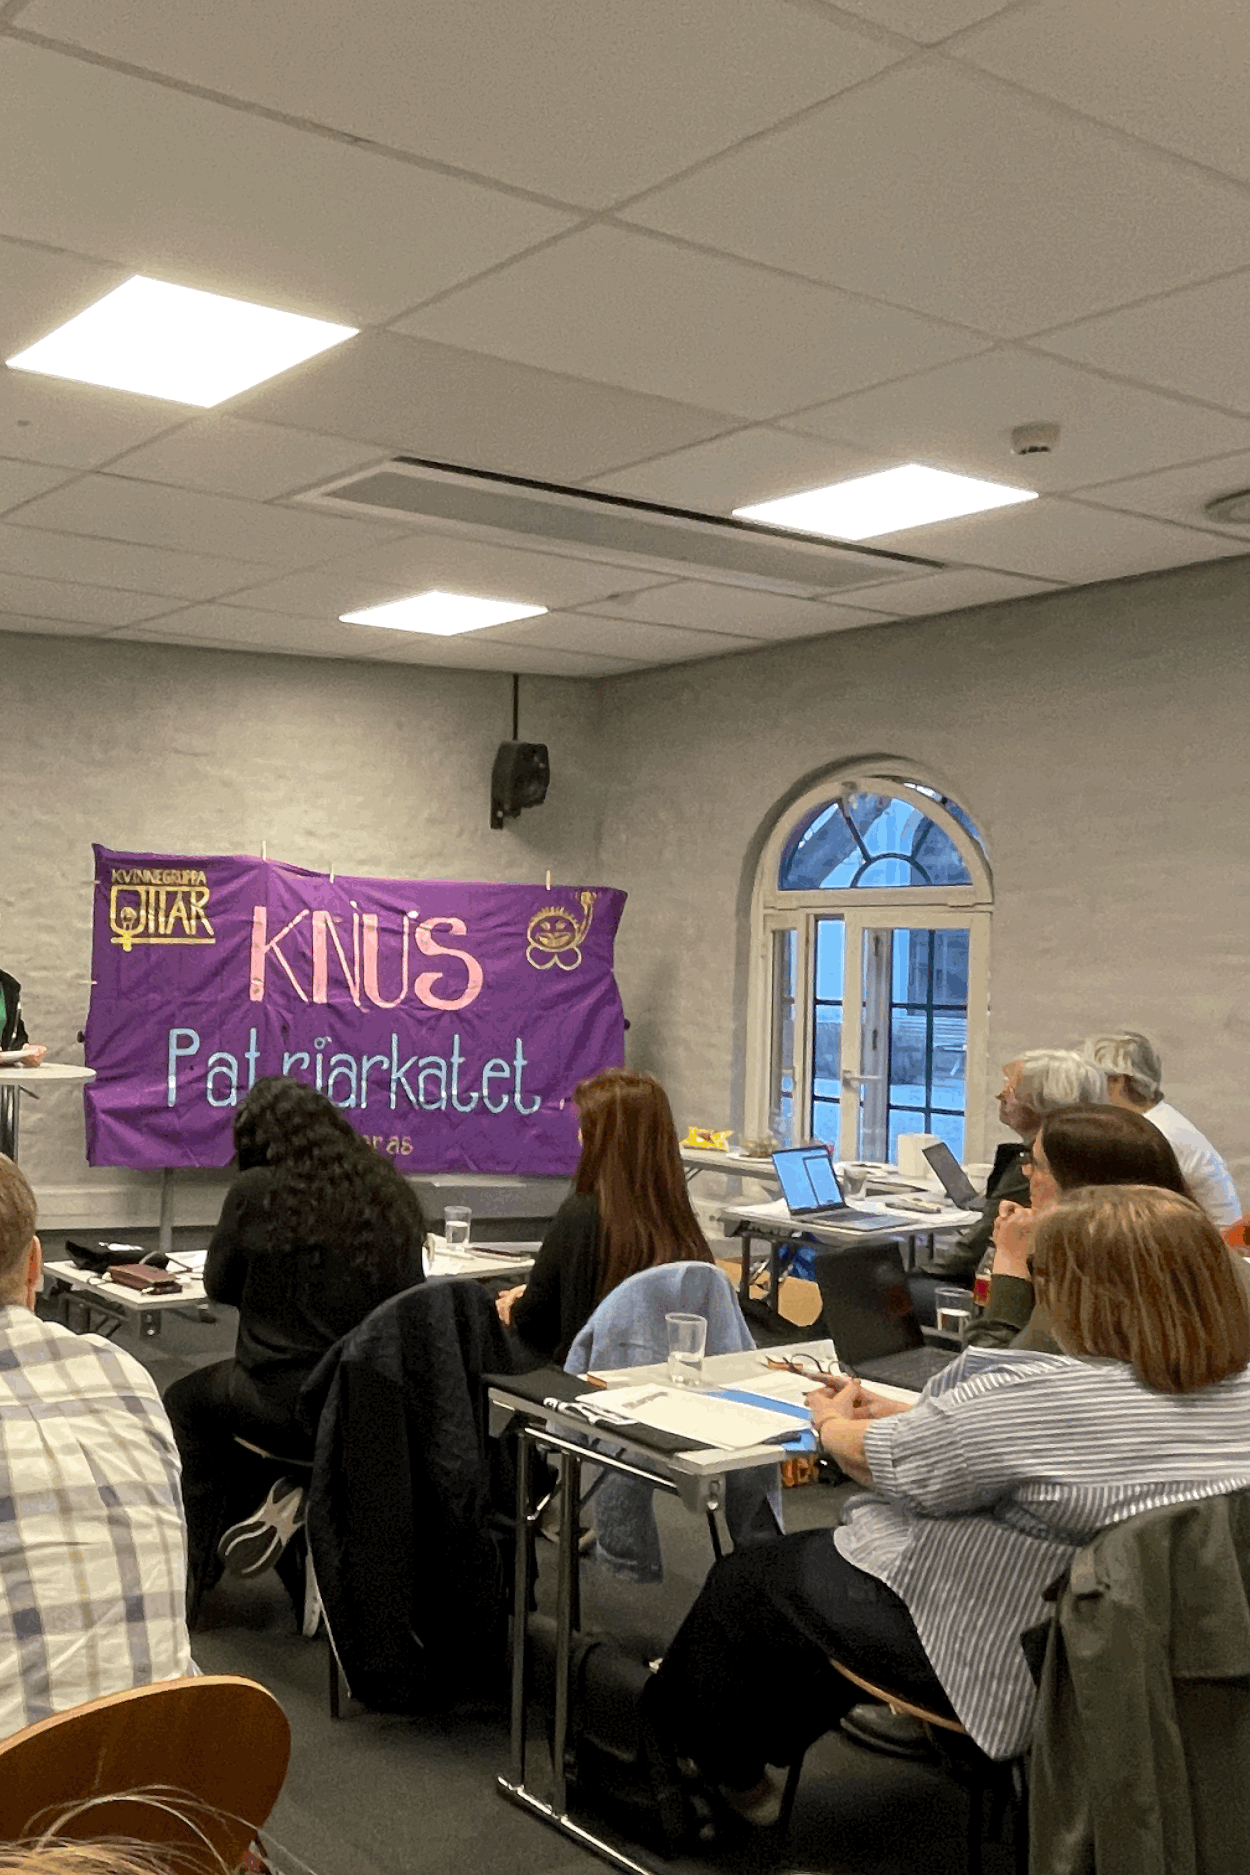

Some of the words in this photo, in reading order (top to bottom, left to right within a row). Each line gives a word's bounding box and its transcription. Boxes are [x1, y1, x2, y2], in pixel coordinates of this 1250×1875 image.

[111, 868, 208, 885] KVINNEGRUPPA
[110, 884, 215, 937] OTTAR
[249, 905, 484, 1013] KNUS
